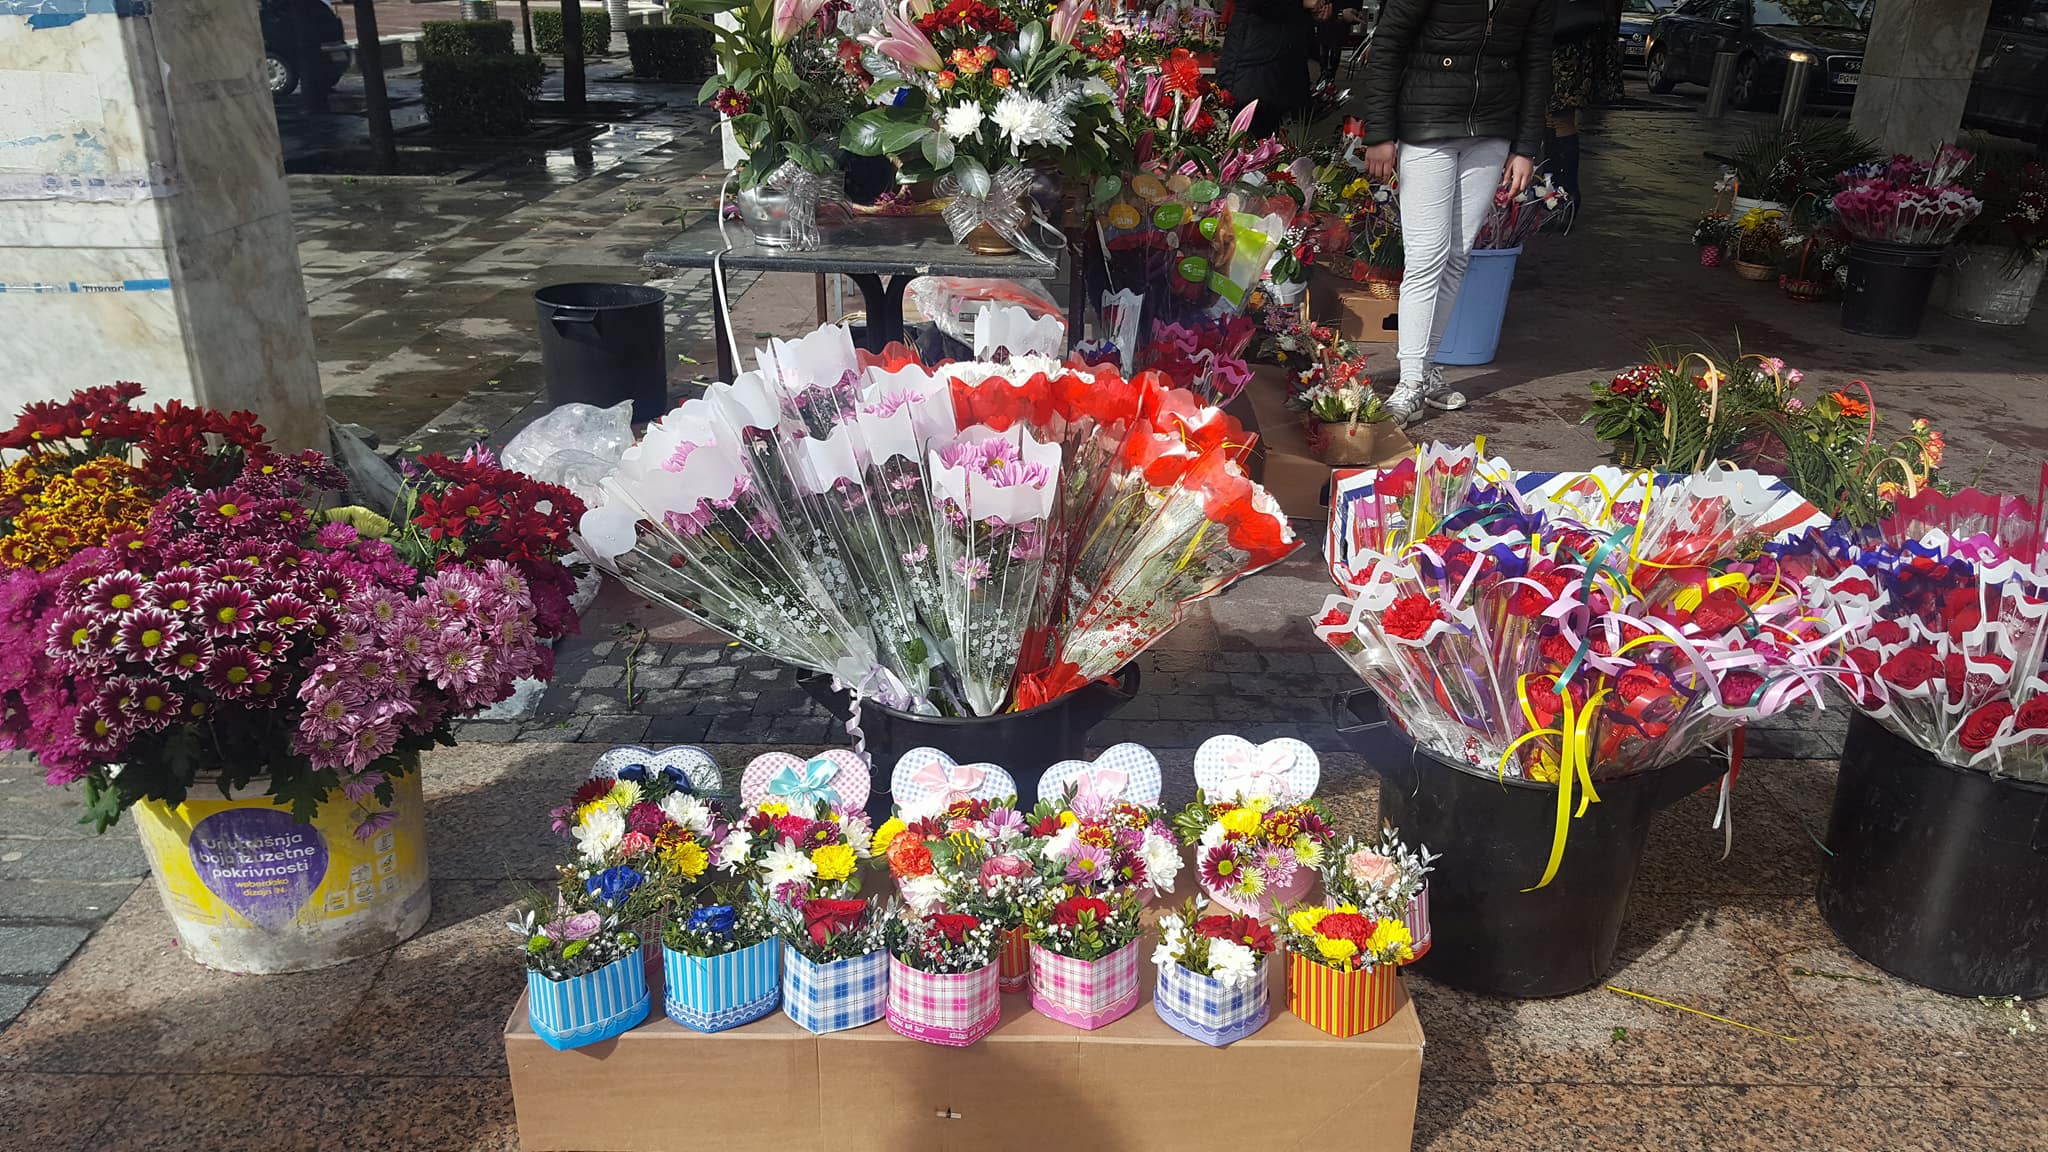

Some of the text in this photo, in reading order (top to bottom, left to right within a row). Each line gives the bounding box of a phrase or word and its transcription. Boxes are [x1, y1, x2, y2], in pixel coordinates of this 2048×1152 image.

[201, 846, 315, 866] boja izuzetne
[212, 859, 310, 880] pokrivnosti
